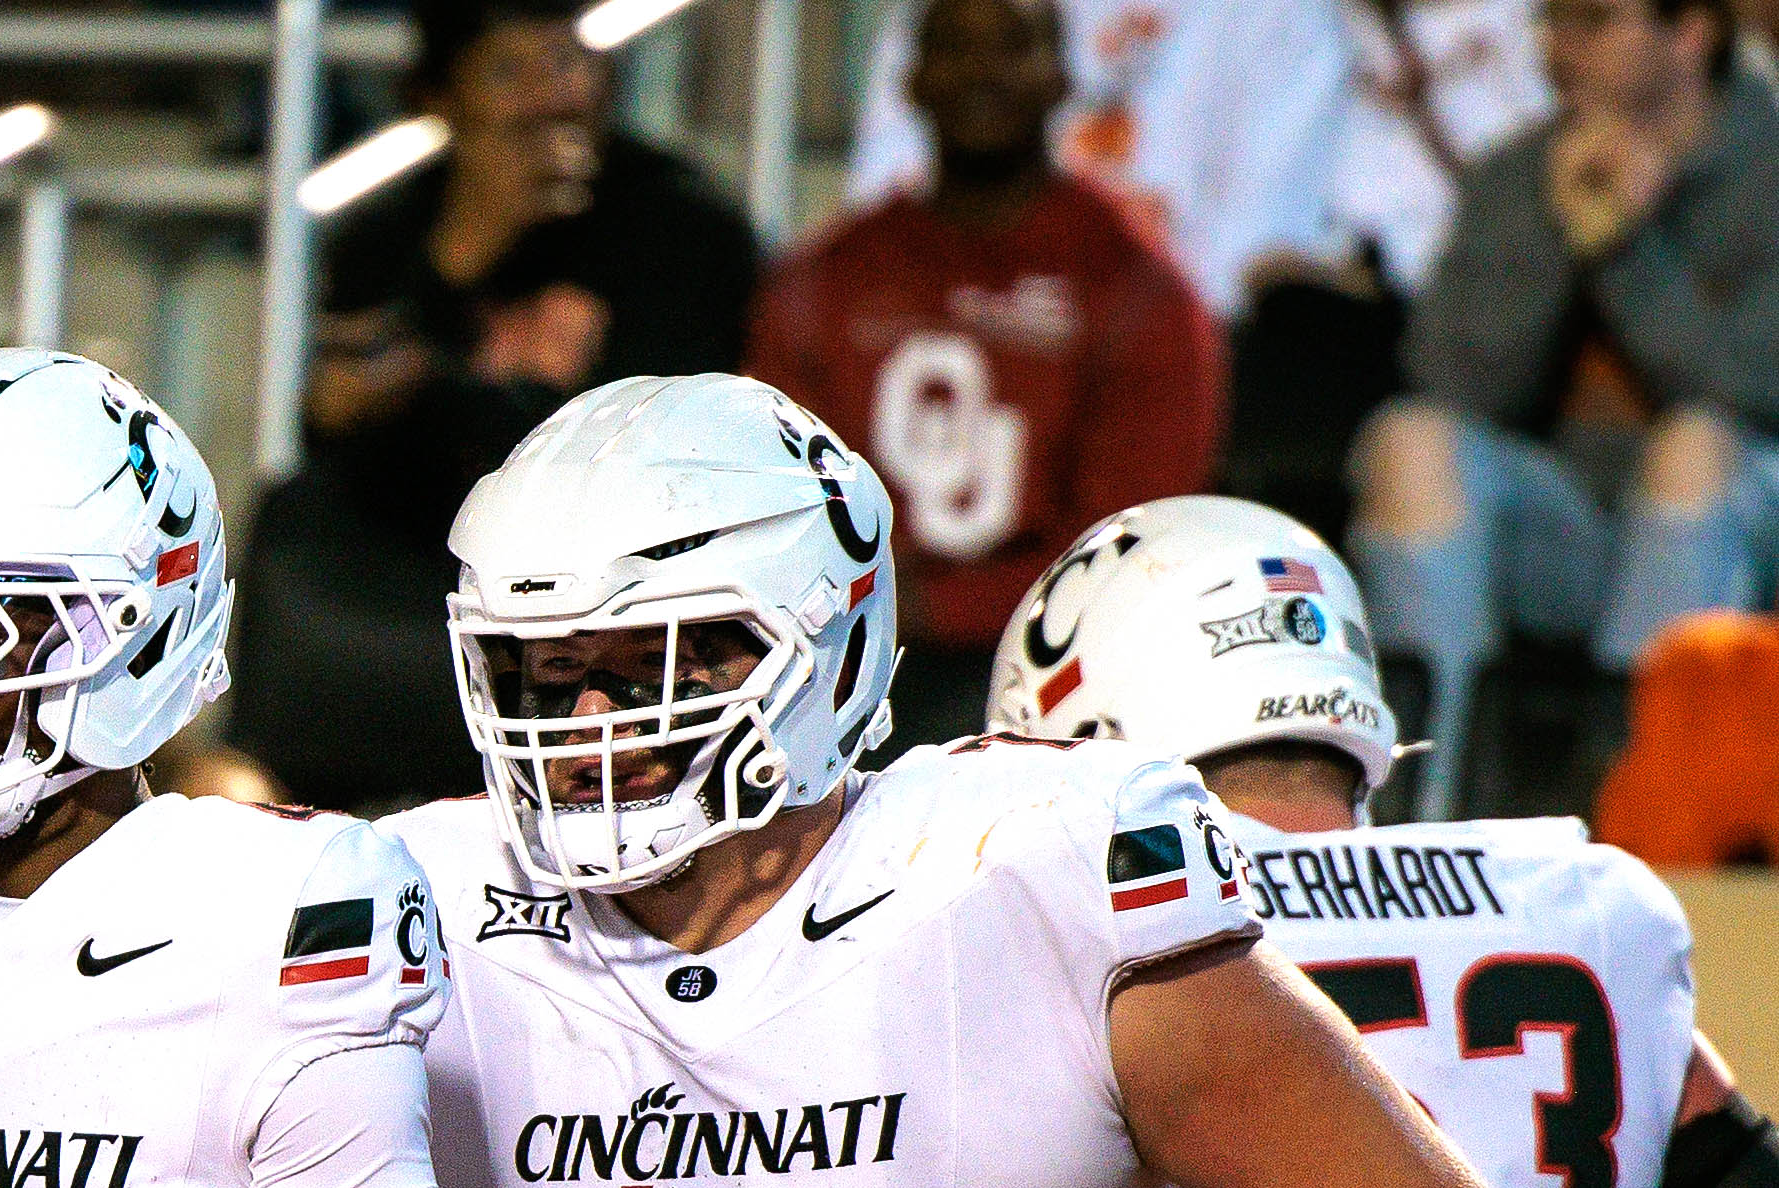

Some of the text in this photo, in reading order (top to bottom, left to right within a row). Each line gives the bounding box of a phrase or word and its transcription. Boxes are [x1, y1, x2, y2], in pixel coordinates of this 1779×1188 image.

[1254, 687, 1380, 729] BEARCATS
[681, 966, 706, 982] JK
[676, 981, 702, 998] 58
